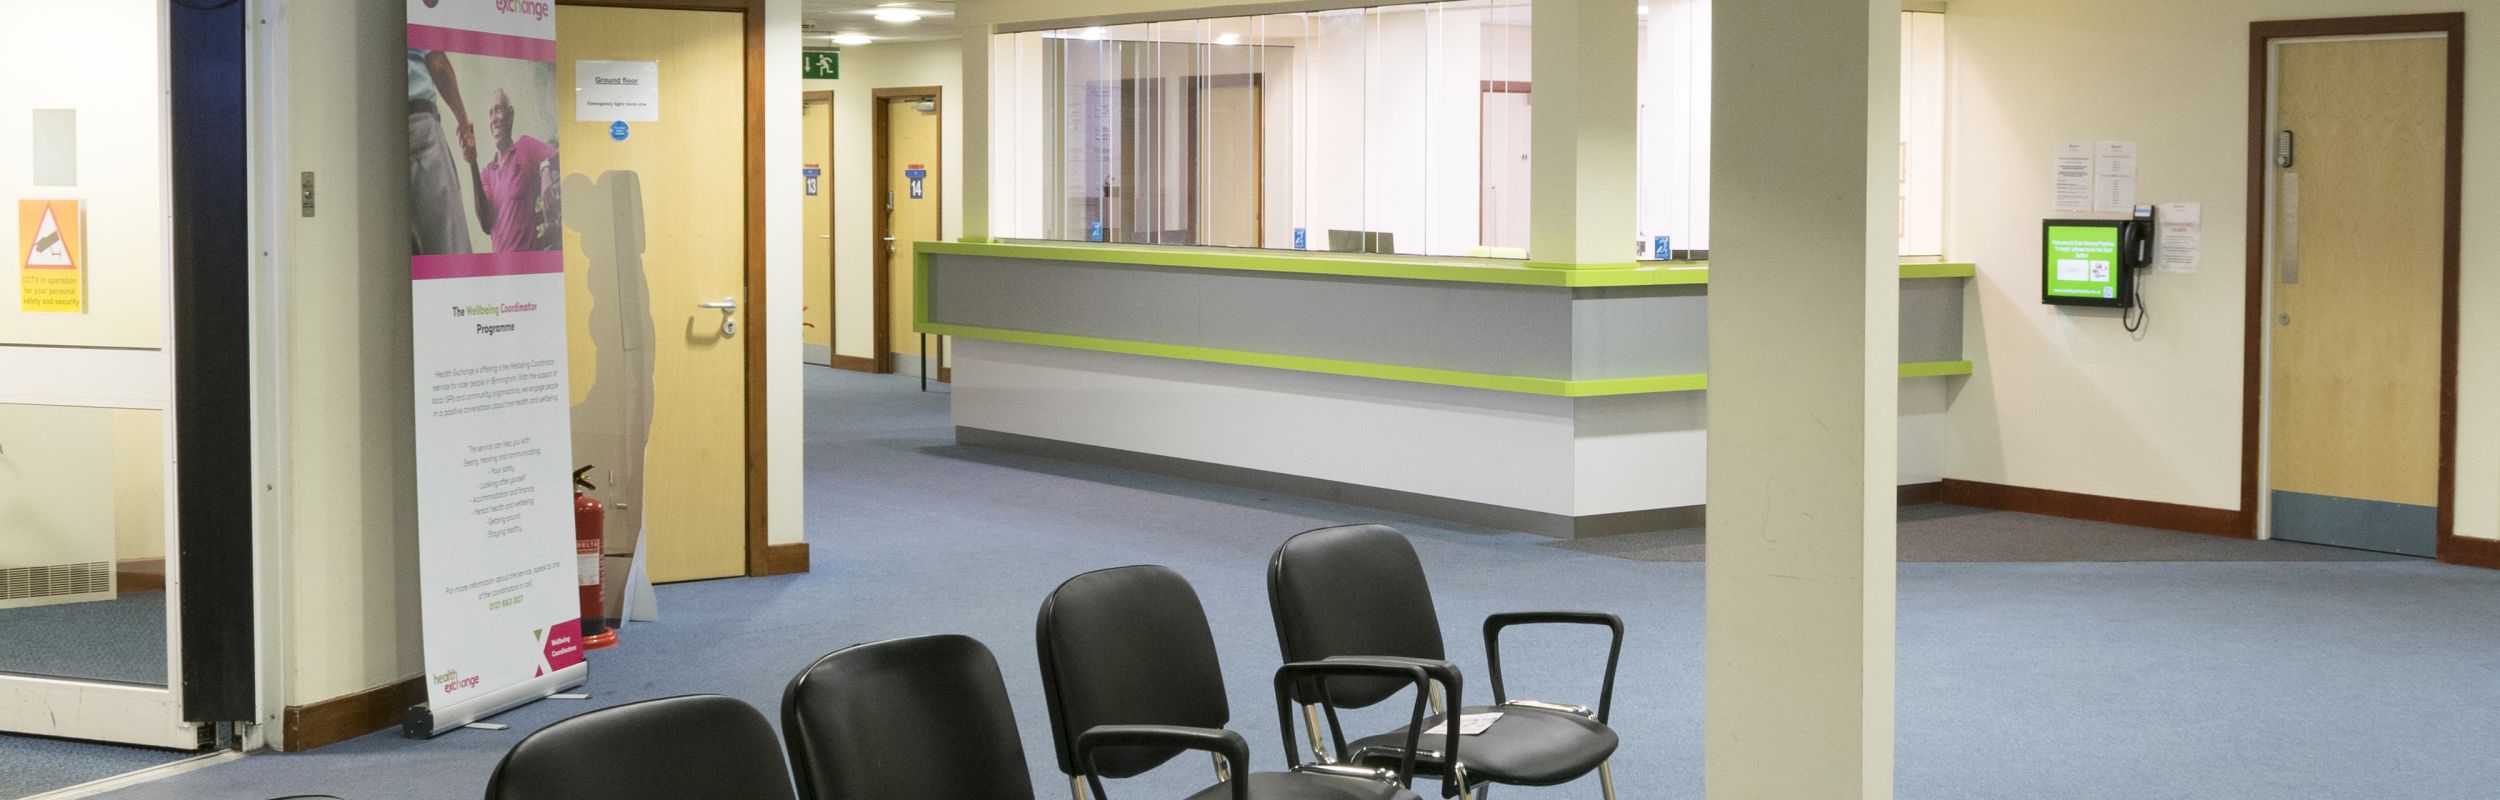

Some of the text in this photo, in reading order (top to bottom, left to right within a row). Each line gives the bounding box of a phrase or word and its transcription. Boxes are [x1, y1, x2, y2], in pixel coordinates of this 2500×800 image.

[595, 77, 639, 86] Ground floor
[807, 179, 817, 194] 13
[911, 180, 922, 196] 14
[23, 276, 39, 284] CCTV
[48, 277, 78, 286] operation
[49, 288, 76, 296] personal
[23, 298, 41, 307] safety
[55, 298, 80, 307] security
[452, 302, 538, 317] The Wellbeing Coordinator
[477, 324, 515, 336] Programme
[577, 541, 598, 549] DELTA
[552, 636, 571, 647] Wellbeing
[552, 645, 577, 658] Coordinators
[433, 668, 459, 685] health
[445, 675, 480, 693] exchange
